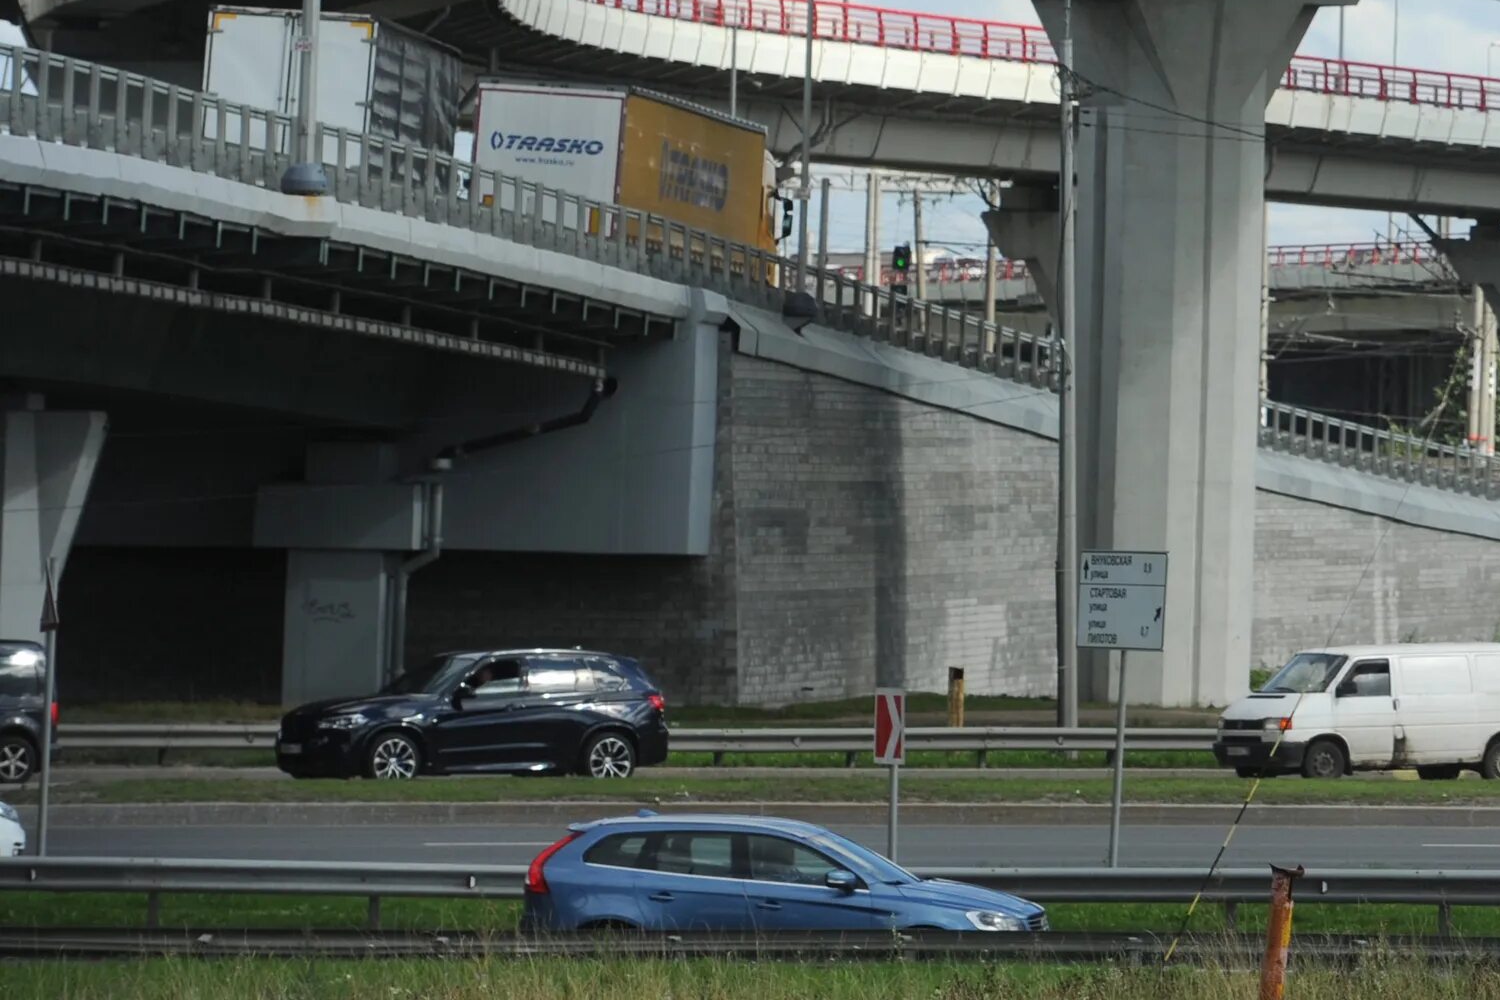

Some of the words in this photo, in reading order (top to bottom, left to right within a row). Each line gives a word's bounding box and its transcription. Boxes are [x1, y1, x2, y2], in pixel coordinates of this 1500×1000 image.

[504, 134, 604, 156] TRASKO
[1091, 555, 1132, 565] ВНУКОВСКАЯ
[1090, 570, 1108, 581] улица
[1089, 588, 1127, 598] СТАРТОВАЯ
[1089, 603, 1107, 613] улица
[1088, 620, 1106, 631] улица
